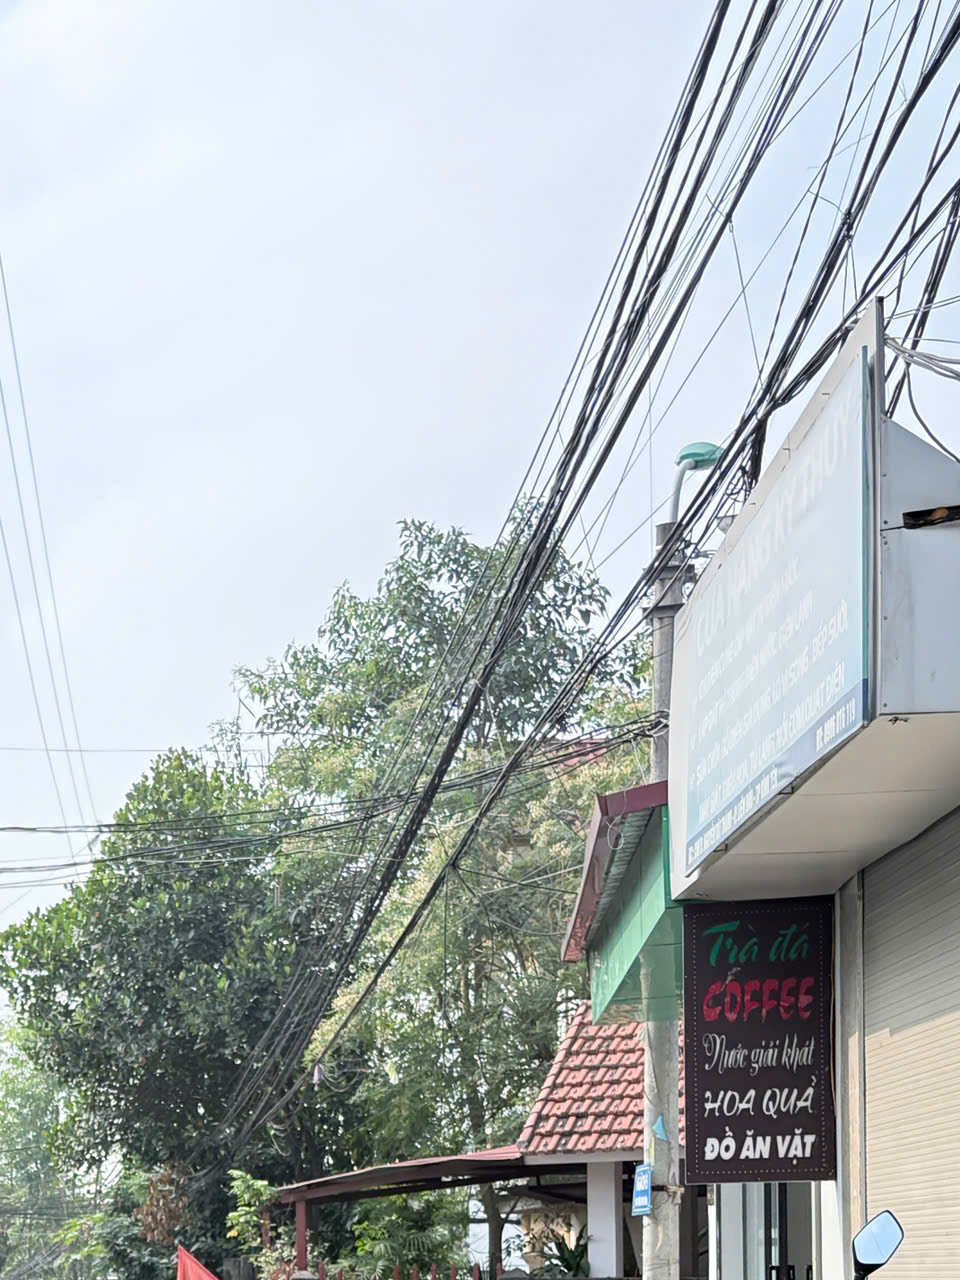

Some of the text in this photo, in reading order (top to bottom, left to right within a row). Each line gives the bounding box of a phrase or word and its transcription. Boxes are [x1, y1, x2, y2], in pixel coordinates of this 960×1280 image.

[703, 919, 810, 967] Trà đá
[703, 975, 815, 1024] COFFEE
[781, 1033, 815, 1073] khát
[704, 1075, 817, 1119] HOA QUẢ
[704, 1126, 816, 1165] ĐỒ ĂN VẶT
